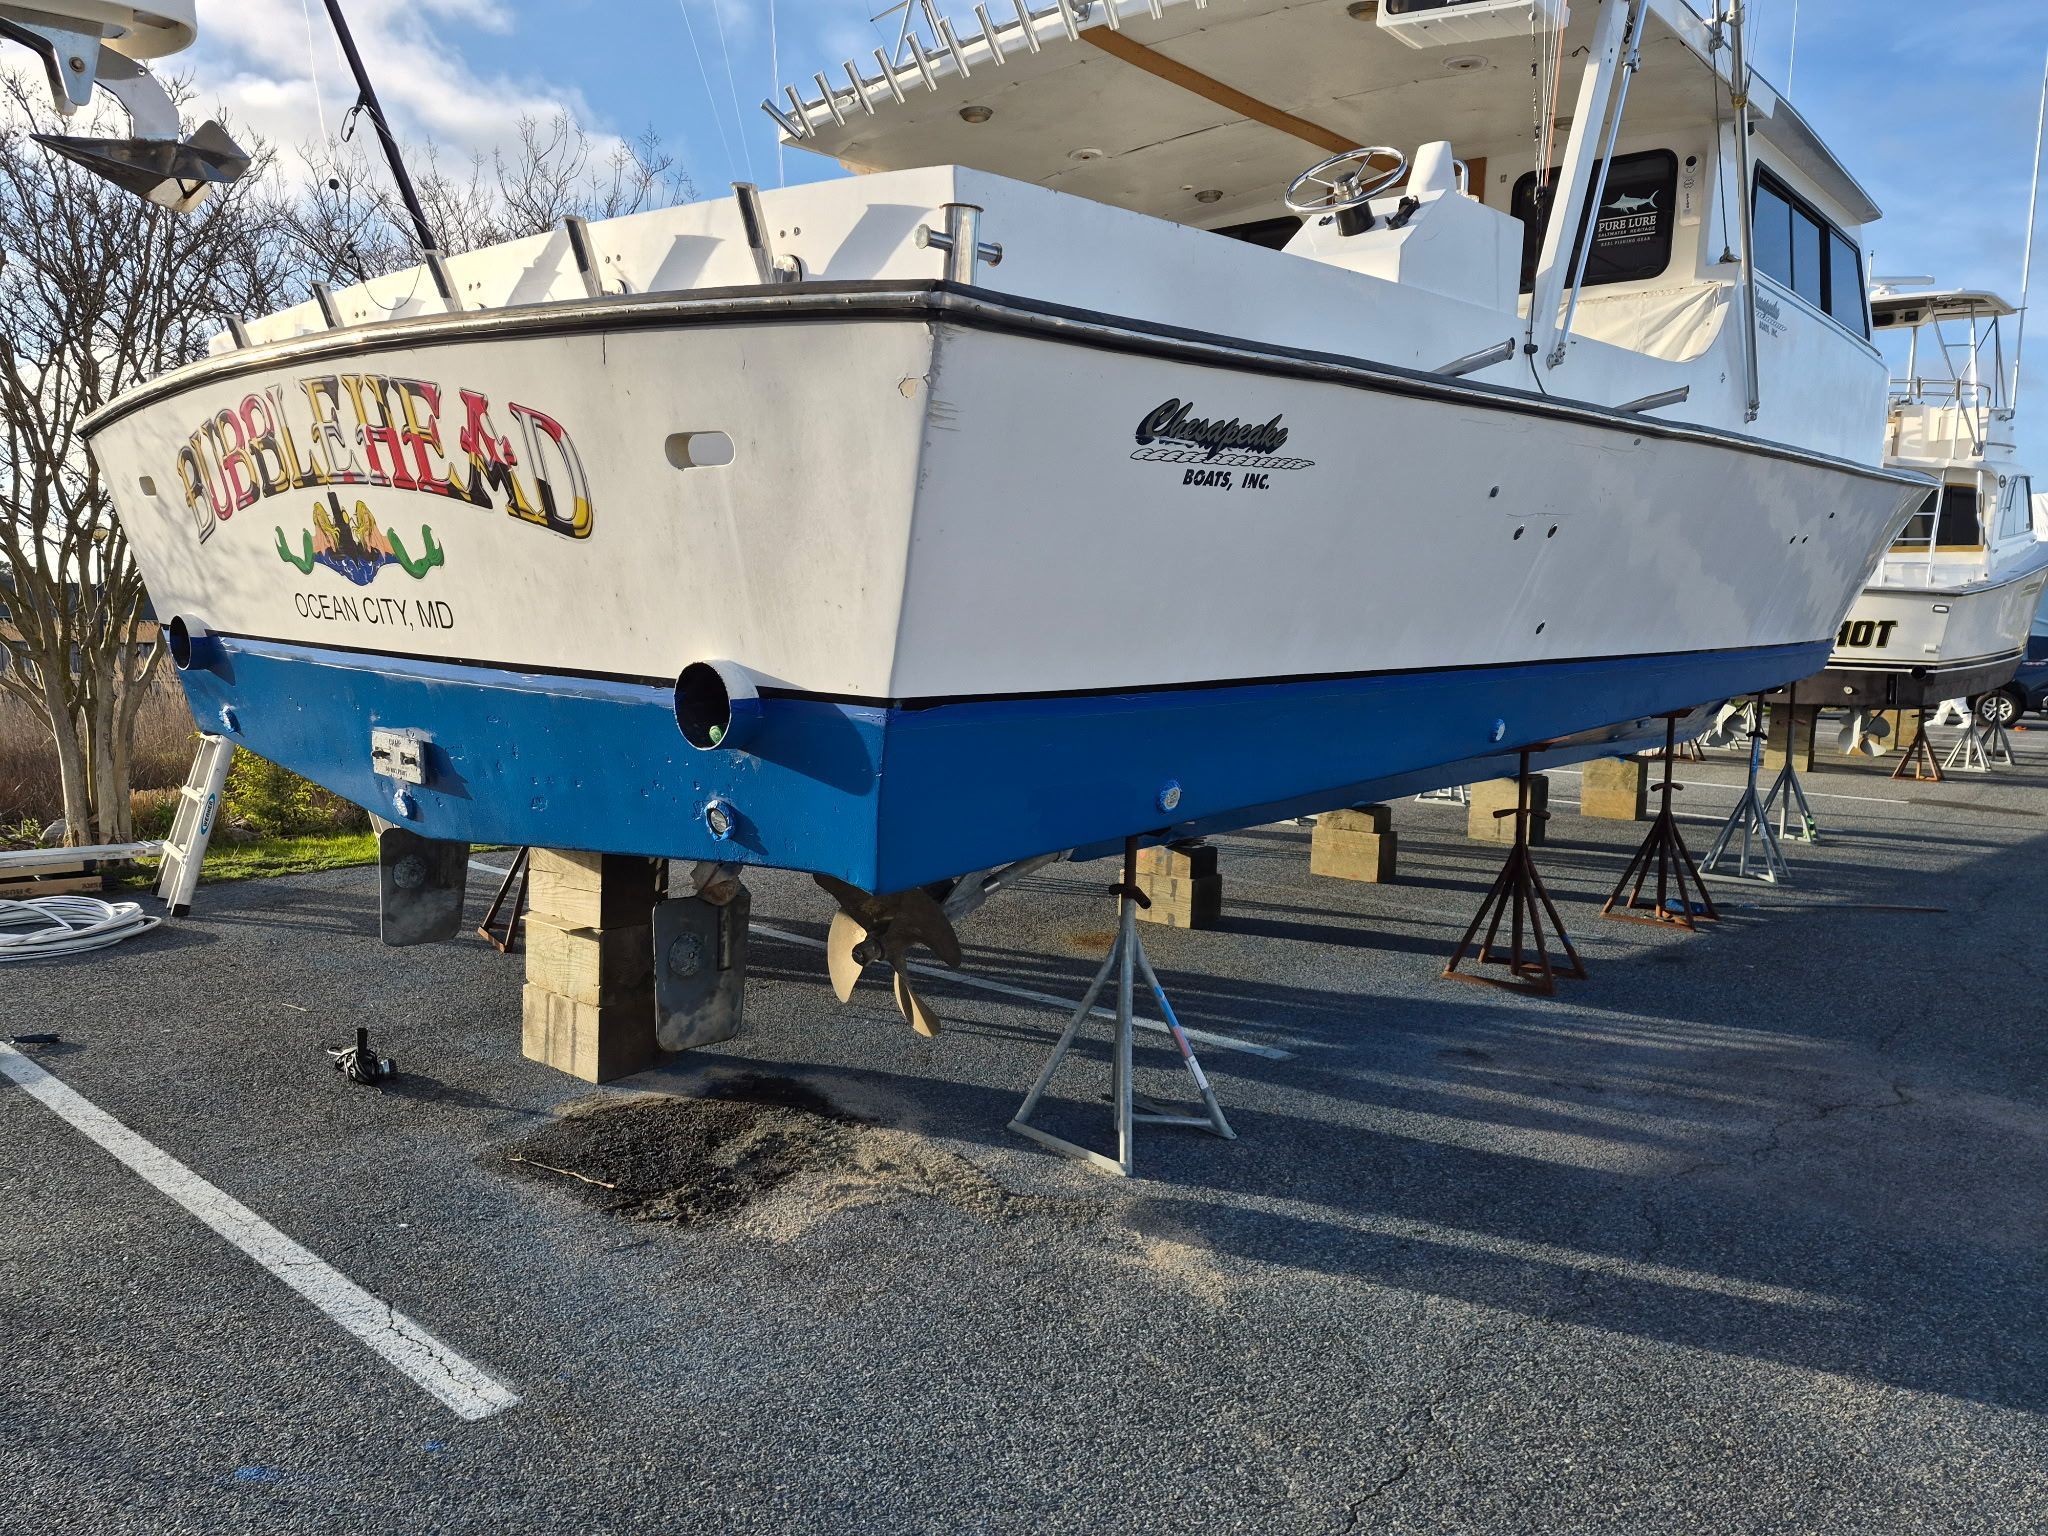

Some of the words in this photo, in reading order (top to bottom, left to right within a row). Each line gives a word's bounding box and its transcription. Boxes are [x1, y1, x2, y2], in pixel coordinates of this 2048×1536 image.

[1598, 219, 1626, 232] PURE
[1628, 215, 1657, 228] LURE
[1135, 397, 1289, 462] Chesapeake
[177, 373, 594, 545] BUBBLEHEAD
[1183, 468, 1233, 491] BOATS,
[1241, 473, 1270, 489] INC.
[294, 592, 361, 624] OCEAN
[362, 598, 415, 631] CITY,
[416, 600, 454, 630] MD
[203, 800, 214, 828] WERNER
